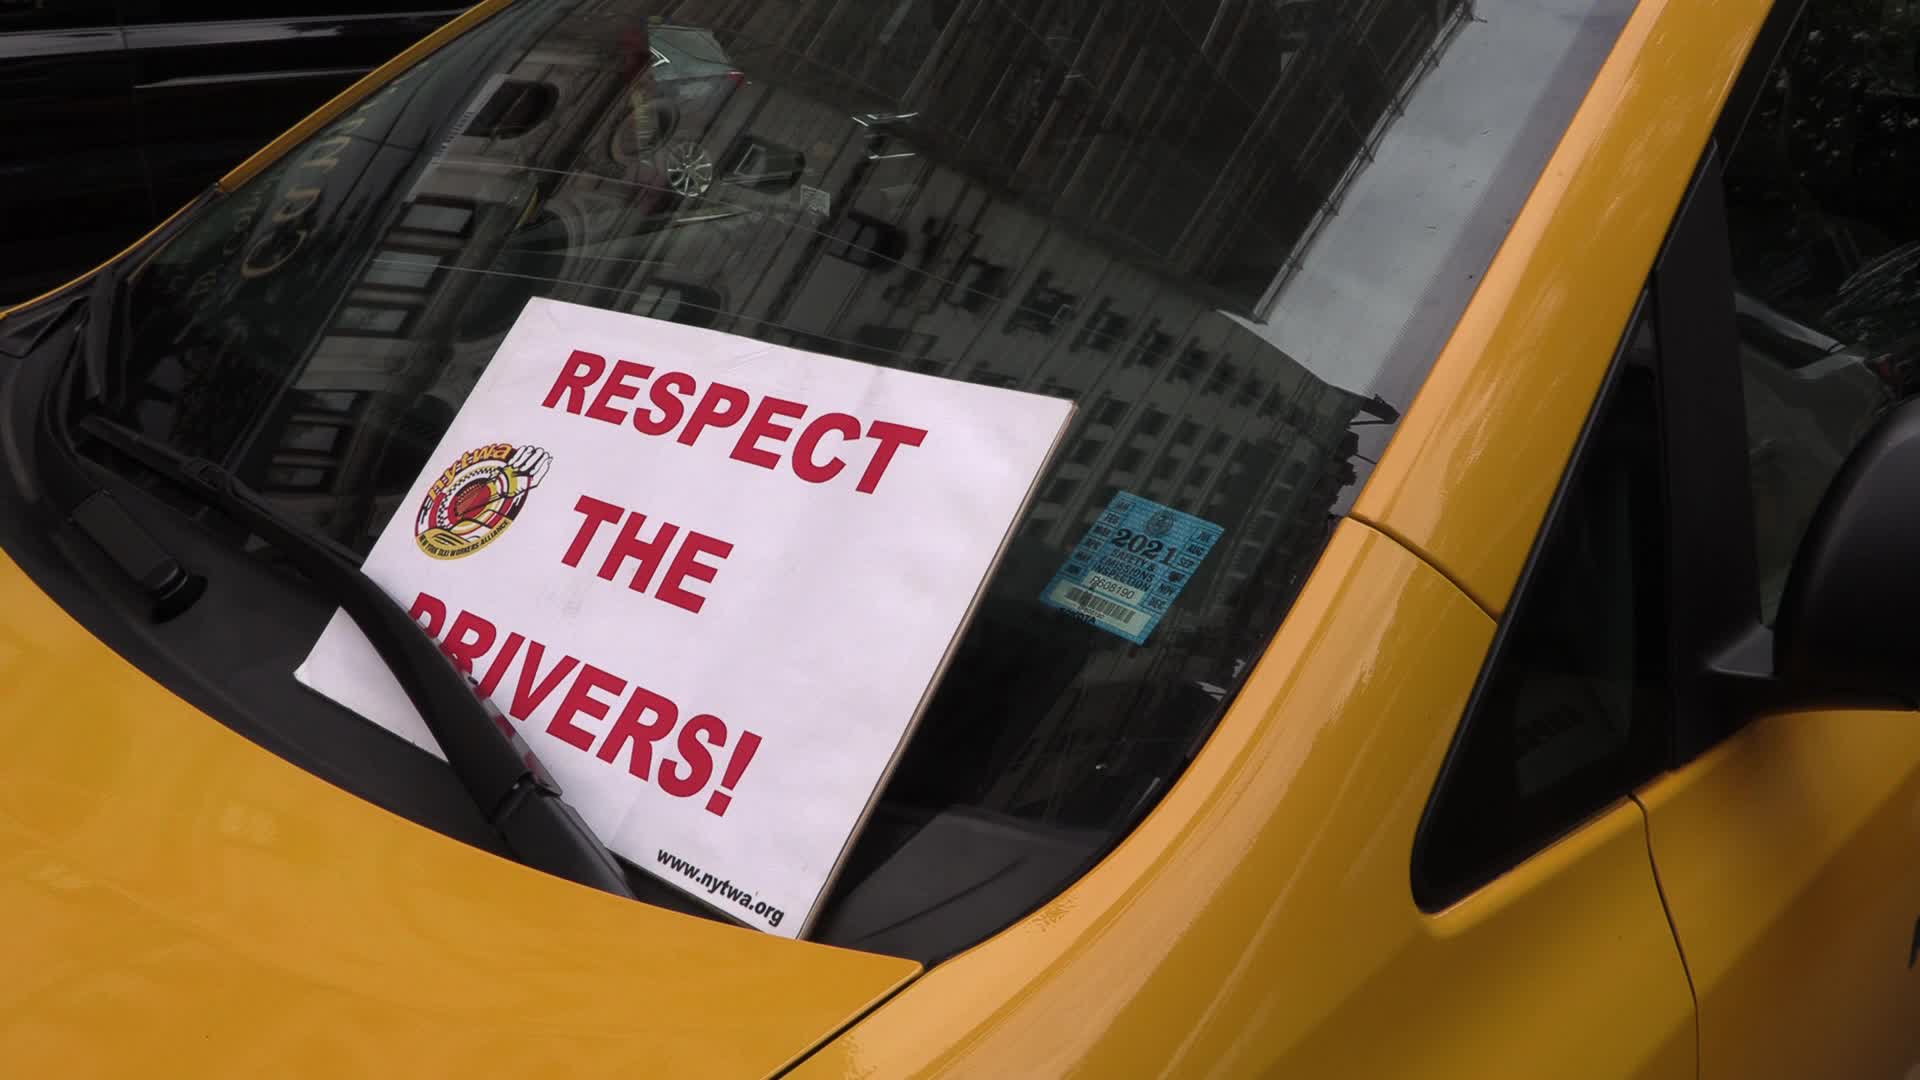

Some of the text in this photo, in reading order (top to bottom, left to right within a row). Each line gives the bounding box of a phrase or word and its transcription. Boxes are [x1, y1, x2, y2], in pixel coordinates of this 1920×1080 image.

[542, 350, 928, 494] RESPECT
[479, 520, 509, 546] ALLIANCE
[1111, 527, 1178, 566] 2021
[561, 495, 734, 614] THE
[1103, 554, 1156, 583] EMISSIONS
[1111, 548, 1148, 568] SAFETY
[1091, 563, 1152, 592] INSPECTION
[656, 848, 785, 928] www.nytwa.org
